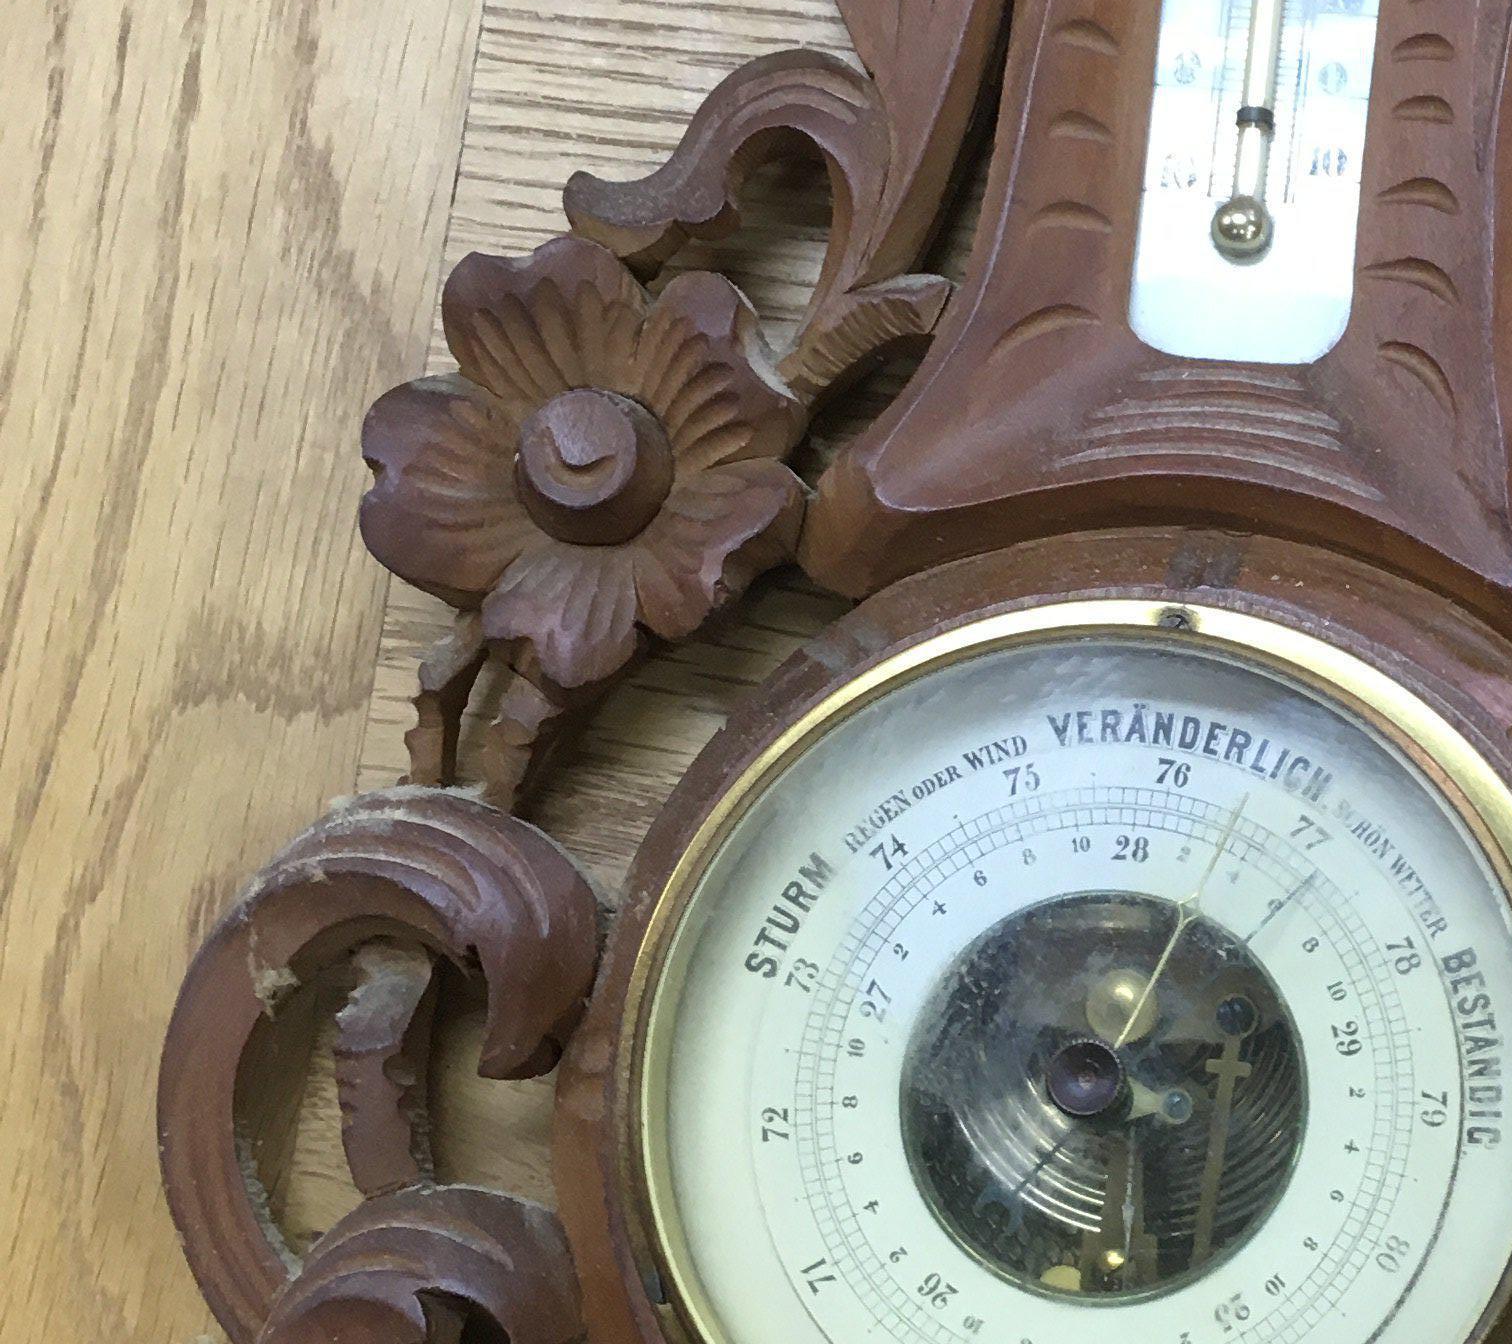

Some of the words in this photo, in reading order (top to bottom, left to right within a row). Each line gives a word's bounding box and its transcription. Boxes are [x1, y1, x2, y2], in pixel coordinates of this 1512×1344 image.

[1002, 762, 1041, 797] 75
[1155, 757, 1192, 788] 76
[843, 790, 913, 854] REGEN
[911, 765, 963, 800] ODER
[962, 734, 1029, 773] WIND
[1071, 835, 1091, 854] 10
[1111, 834, 1150, 864] 28
[1289, 814, 1334, 851] 77
[869, 832, 910, 871] 74
[973, 869, 988, 888] 6
[743, 851, 838, 979] STURM
[893, 942, 910, 961] 2
[1301, 936, 1320, 954] 8
[1386, 935, 1422, 976] 78
[783, 957, 820, 993] 73
[1326, 981, 1348, 1002] 10
[858, 978, 893, 1024] 27
[847, 1038, 866, 1058] 10
[1330, 1020, 1363, 1057] 29
[841, 1094, 858, 1110] 8
[1420, 1089, 1449, 1128] 79
[761, 1106, 790, 1143] 72
[847, 1151, 864, 1166] 6
[888, 1246, 908, 1264] 2
[800, 1257, 837, 1297] 71
[917, 1272, 960, 1309] 26
[1214, 1291, 1251, 1333] 25
